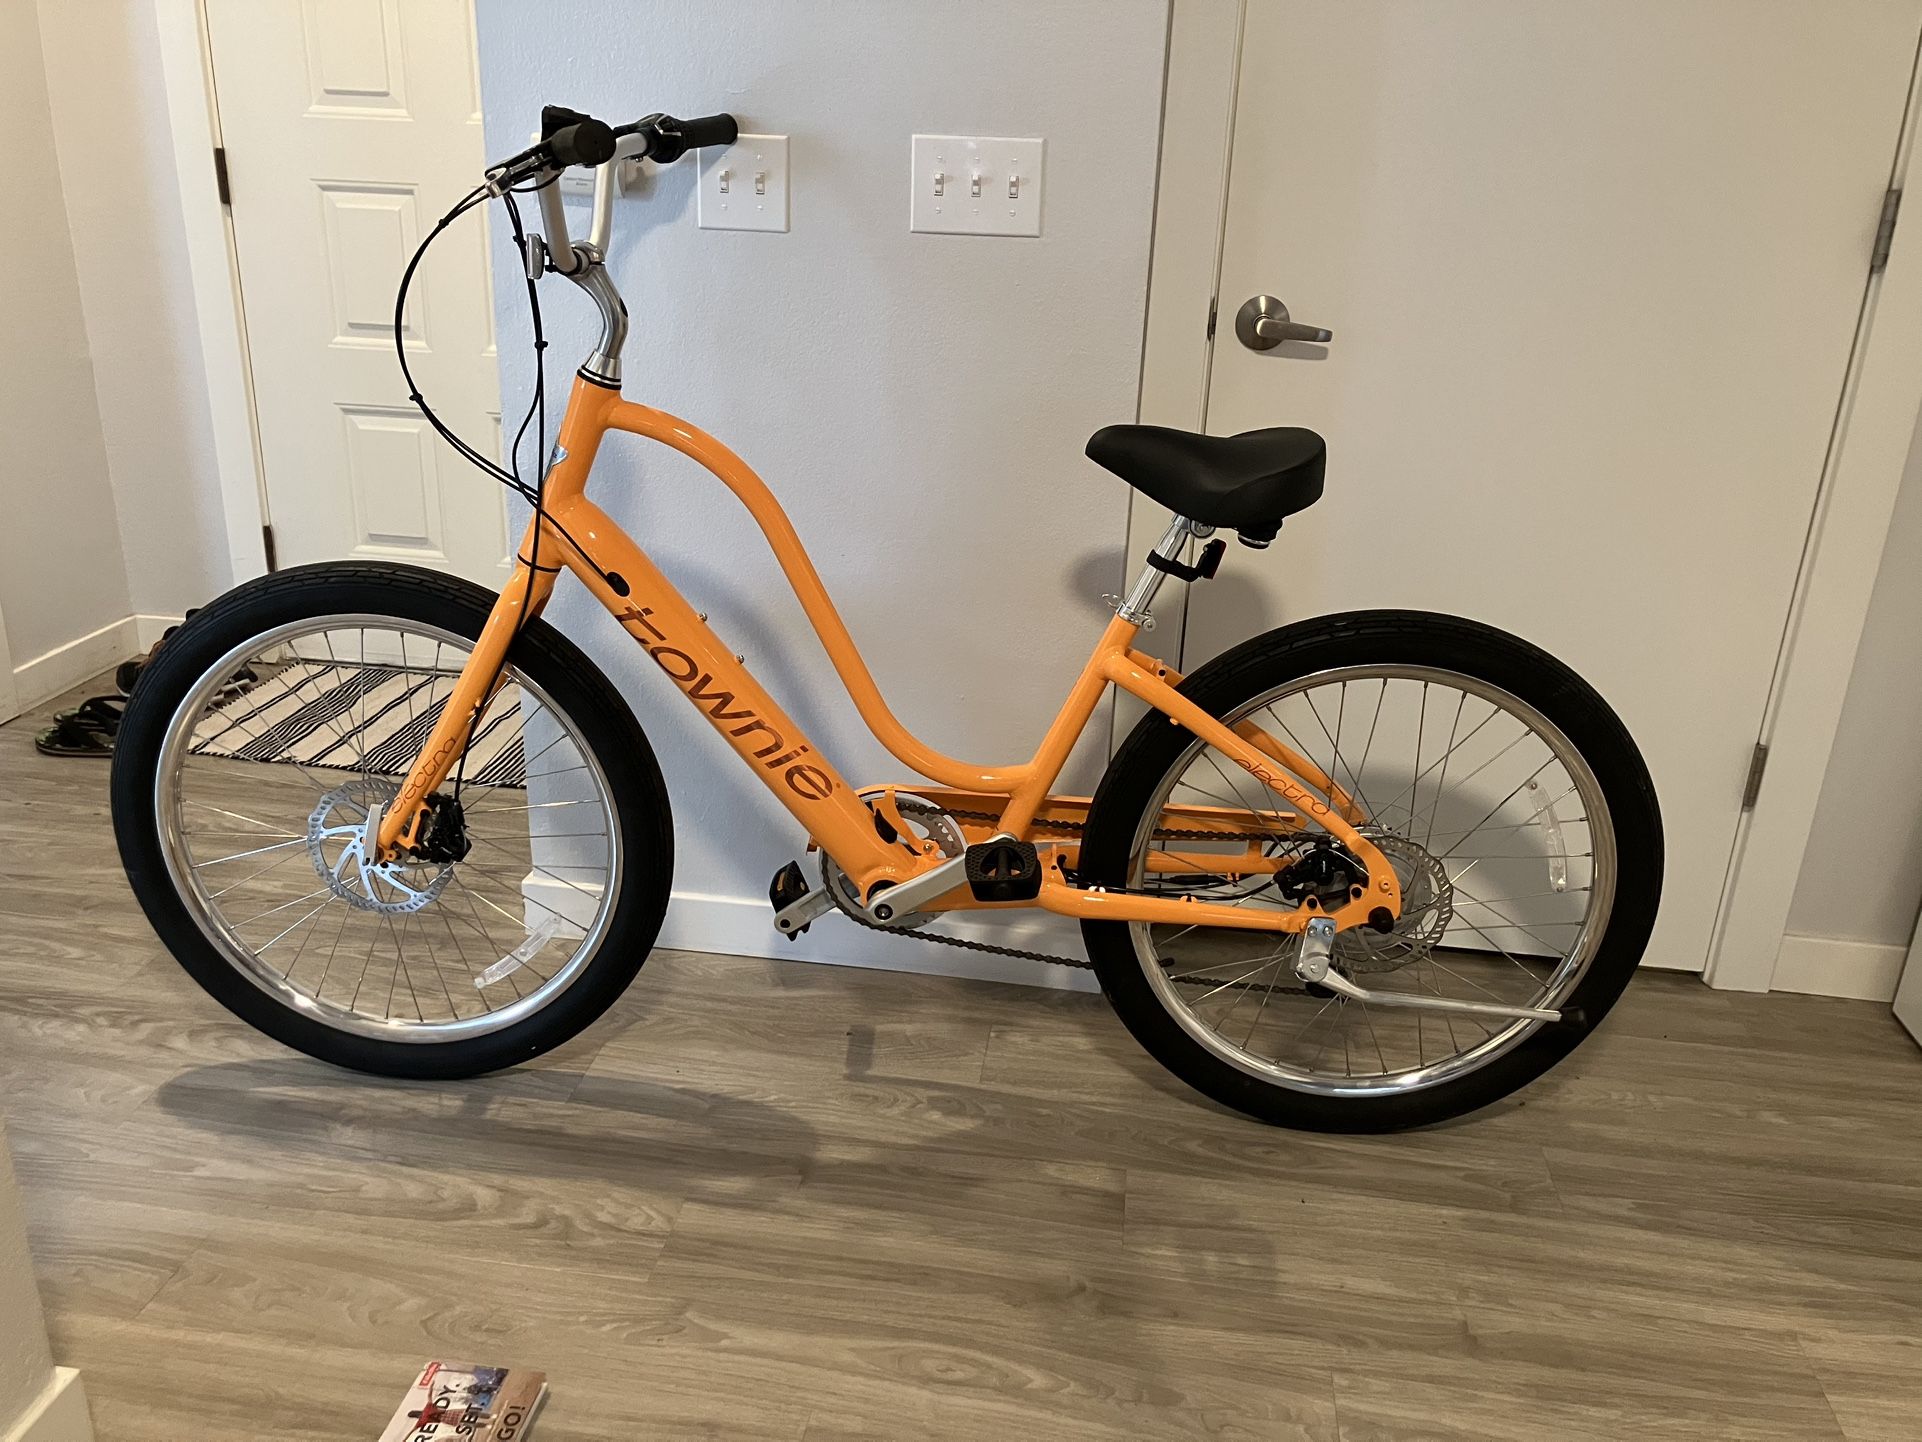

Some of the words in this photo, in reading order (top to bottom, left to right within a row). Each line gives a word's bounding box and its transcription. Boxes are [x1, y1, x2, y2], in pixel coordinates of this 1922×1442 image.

[614, 606, 834, 801] townie
[1233, 758, 1331, 816] electra
[455, 1402, 485, 1436] SET.
[496, 1405, 526, 1441] GO!
